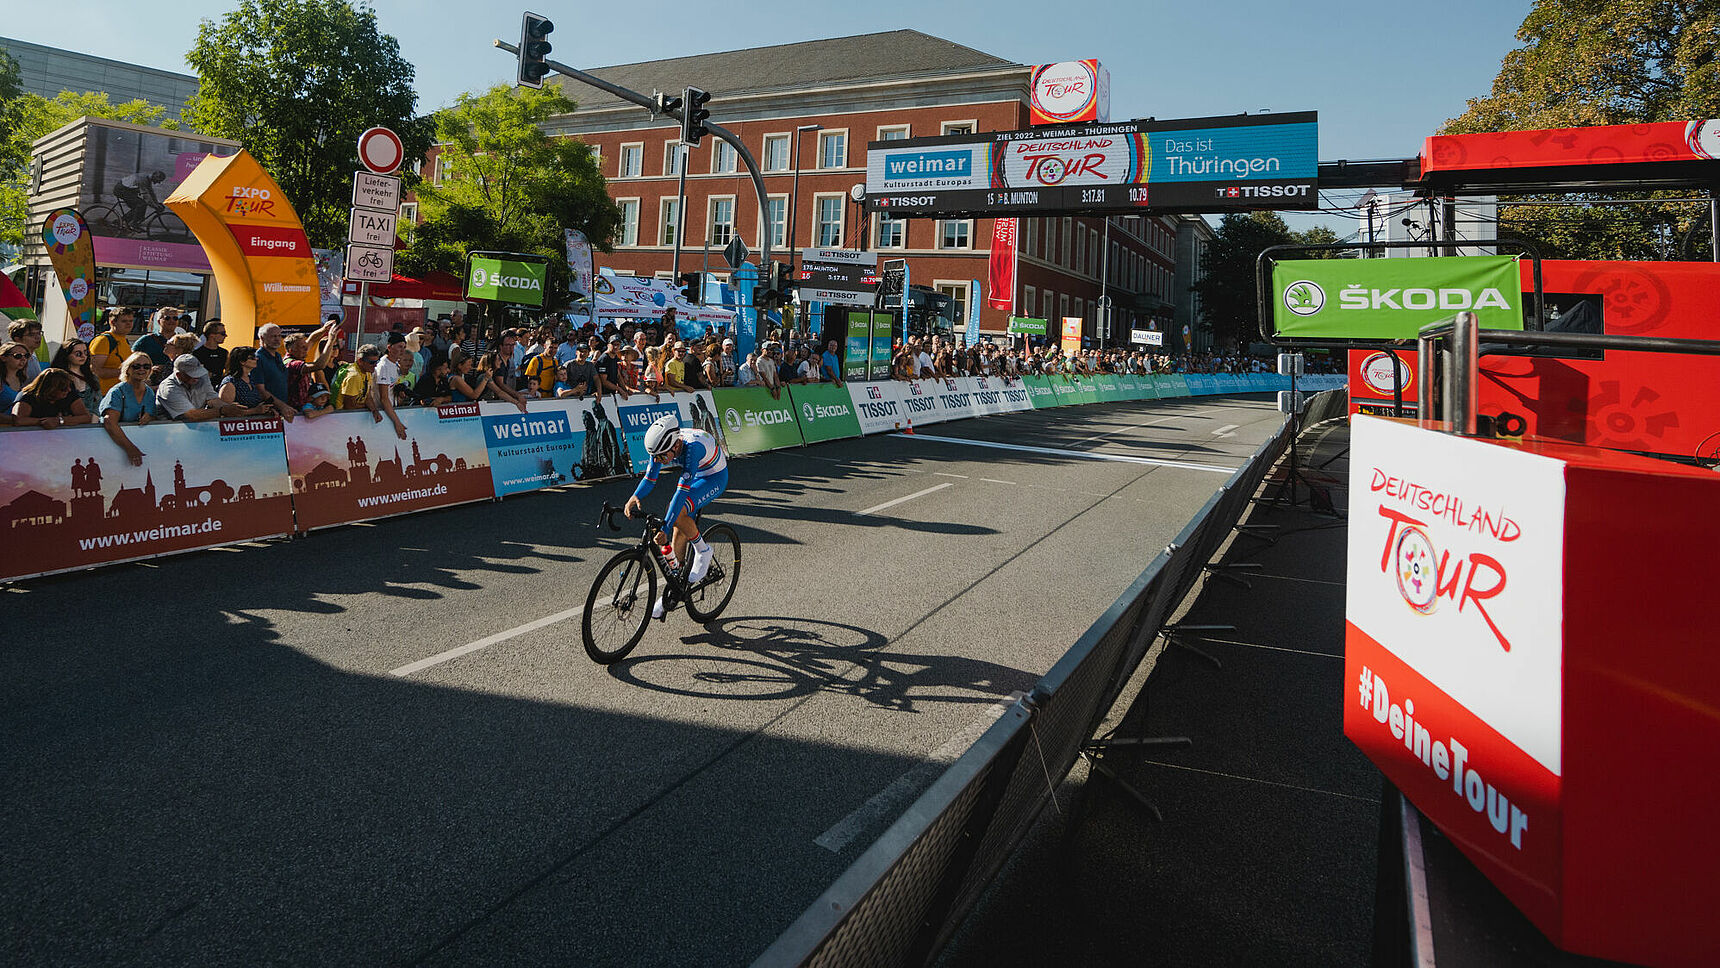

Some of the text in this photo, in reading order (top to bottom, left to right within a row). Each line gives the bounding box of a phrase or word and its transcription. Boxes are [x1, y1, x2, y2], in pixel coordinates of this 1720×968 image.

[1044, 82, 1085, 98] TOUR
[1042, 130, 1076, 138] WEIMAR
[1085, 125, 1138, 135] THÜRINGEN
[1017, 138, 1113, 153] DEUTSCHLAND
[1165, 137, 1214, 153] Das ist
[890, 156, 966, 174] weimar
[1023, 154, 1108, 186] TOUR
[1165, 156, 1280, 178] Thüringen
[364, 177, 391, 187] Liefer-
[883, 179, 972, 188] Kulturstadt Europas
[232, 186, 271, 200] EXPO
[362, 187, 393, 198] verkehr
[987, 189, 1105, 205] 15 B. MUNTON 3:17.81
[1129, 188, 1147, 201] 10.79
[1241, 185, 1311, 197] TISSOT
[225, 196, 277, 217] TOUR
[370, 196, 384, 206] frei
[890, 196, 936, 207] TISSOT
[359, 215, 390, 232] TAXI
[56, 226, 77, 237] TOUR
[366, 233, 380, 241] frei
[251, 236, 296, 250] Eingang
[832, 251, 861, 259] TISSOT
[363, 268, 377, 278] frei
[263, 282, 311, 292] Willkommen
[489, 272, 541, 291] ŠKODA
[829, 291, 858, 300] TISSOT
[1339, 284, 1512, 310] ŠKODA
[1020, 321, 1045, 330] ŠKODA
[1133, 332, 1161, 340] DAUNER
[939, 393, 972, 409] TISSOT
[973, 390, 1001, 406] TISSOT
[1002, 389, 1028, 403] TISSOT
[440, 405, 478, 416] weimar
[815, 404, 851, 418] ŠKODA
[858, 400, 898, 419] TISSOT
[904, 396, 936, 413] TISSOT
[223, 419, 279, 432] weimar
[744, 409, 794, 427] ŠKODA
[492, 416, 565, 440] weimar
[497, 443, 575, 458] Kulturstadt Europas
[503, 471, 560, 486] www.weimar.de
[357, 483, 448, 509] www.weimar.de
[1370, 466, 1521, 543] DEUTSCHLAND
[79, 517, 223, 551] www.weimar.de
[1378, 504, 1512, 652] TOUR
[1359, 665, 1528, 850] #DeineTour
